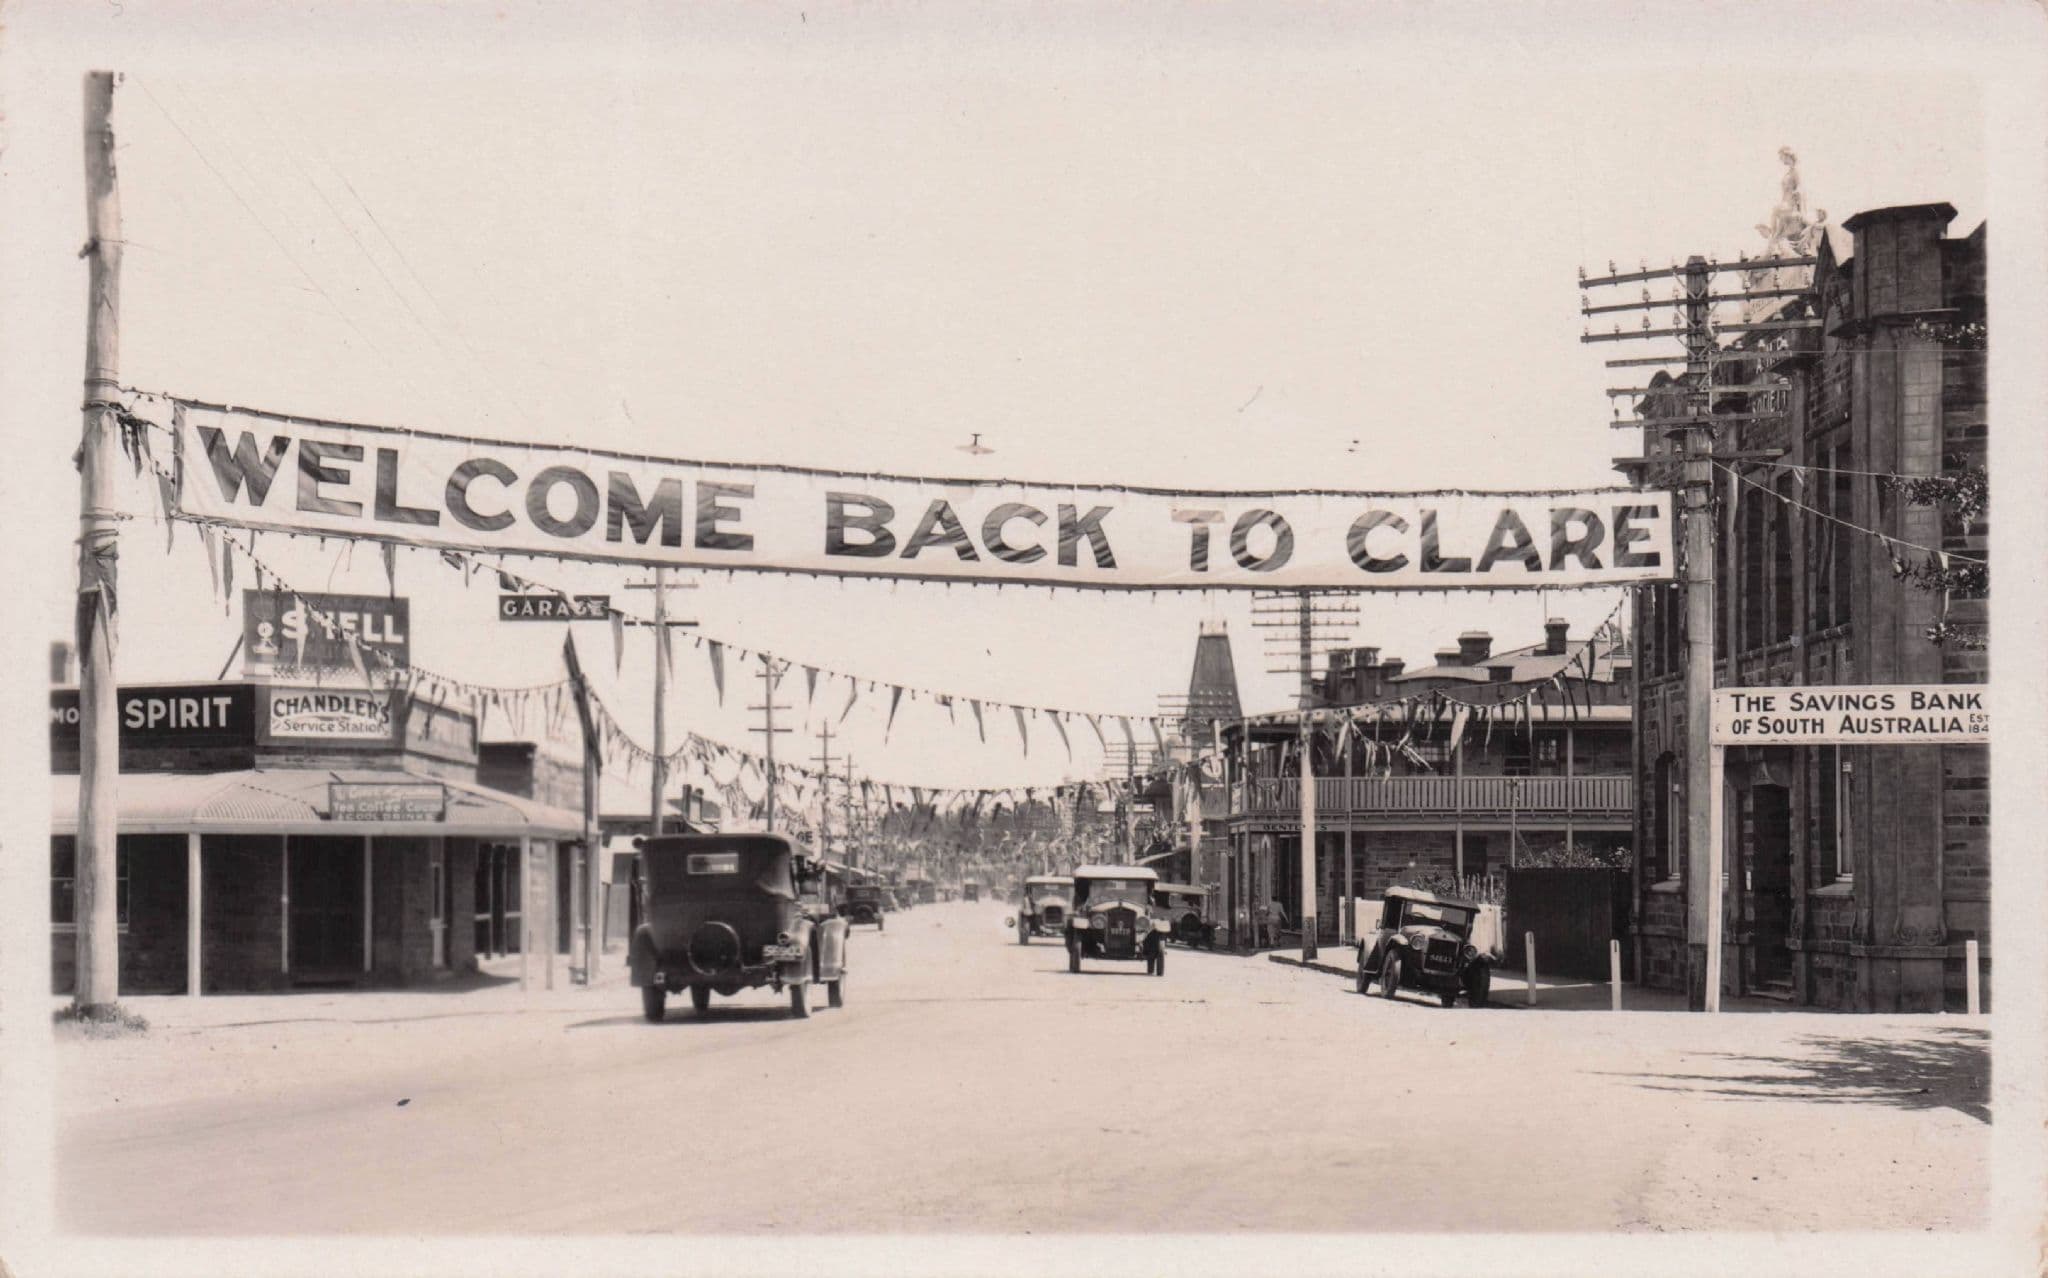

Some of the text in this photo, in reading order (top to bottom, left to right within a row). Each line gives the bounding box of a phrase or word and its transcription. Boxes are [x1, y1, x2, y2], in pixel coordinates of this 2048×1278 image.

[196, 425, 1661, 574] WELCOME BACK TO CLARE
[503, 599, 604, 617] GARAGE
[273, 695, 390, 724] CHANDLER'S
[1730, 691, 1982, 713] THE SAVINGS BANK
[125, 697, 232, 729] SPIRIT
[1969, 713, 1990, 723] EST
[283, 718, 386, 734] Service Station
[1732, 714, 1965, 735] OF SOUTH AUSTRALIA
[1263, 823, 1328, 831] BENTLS
